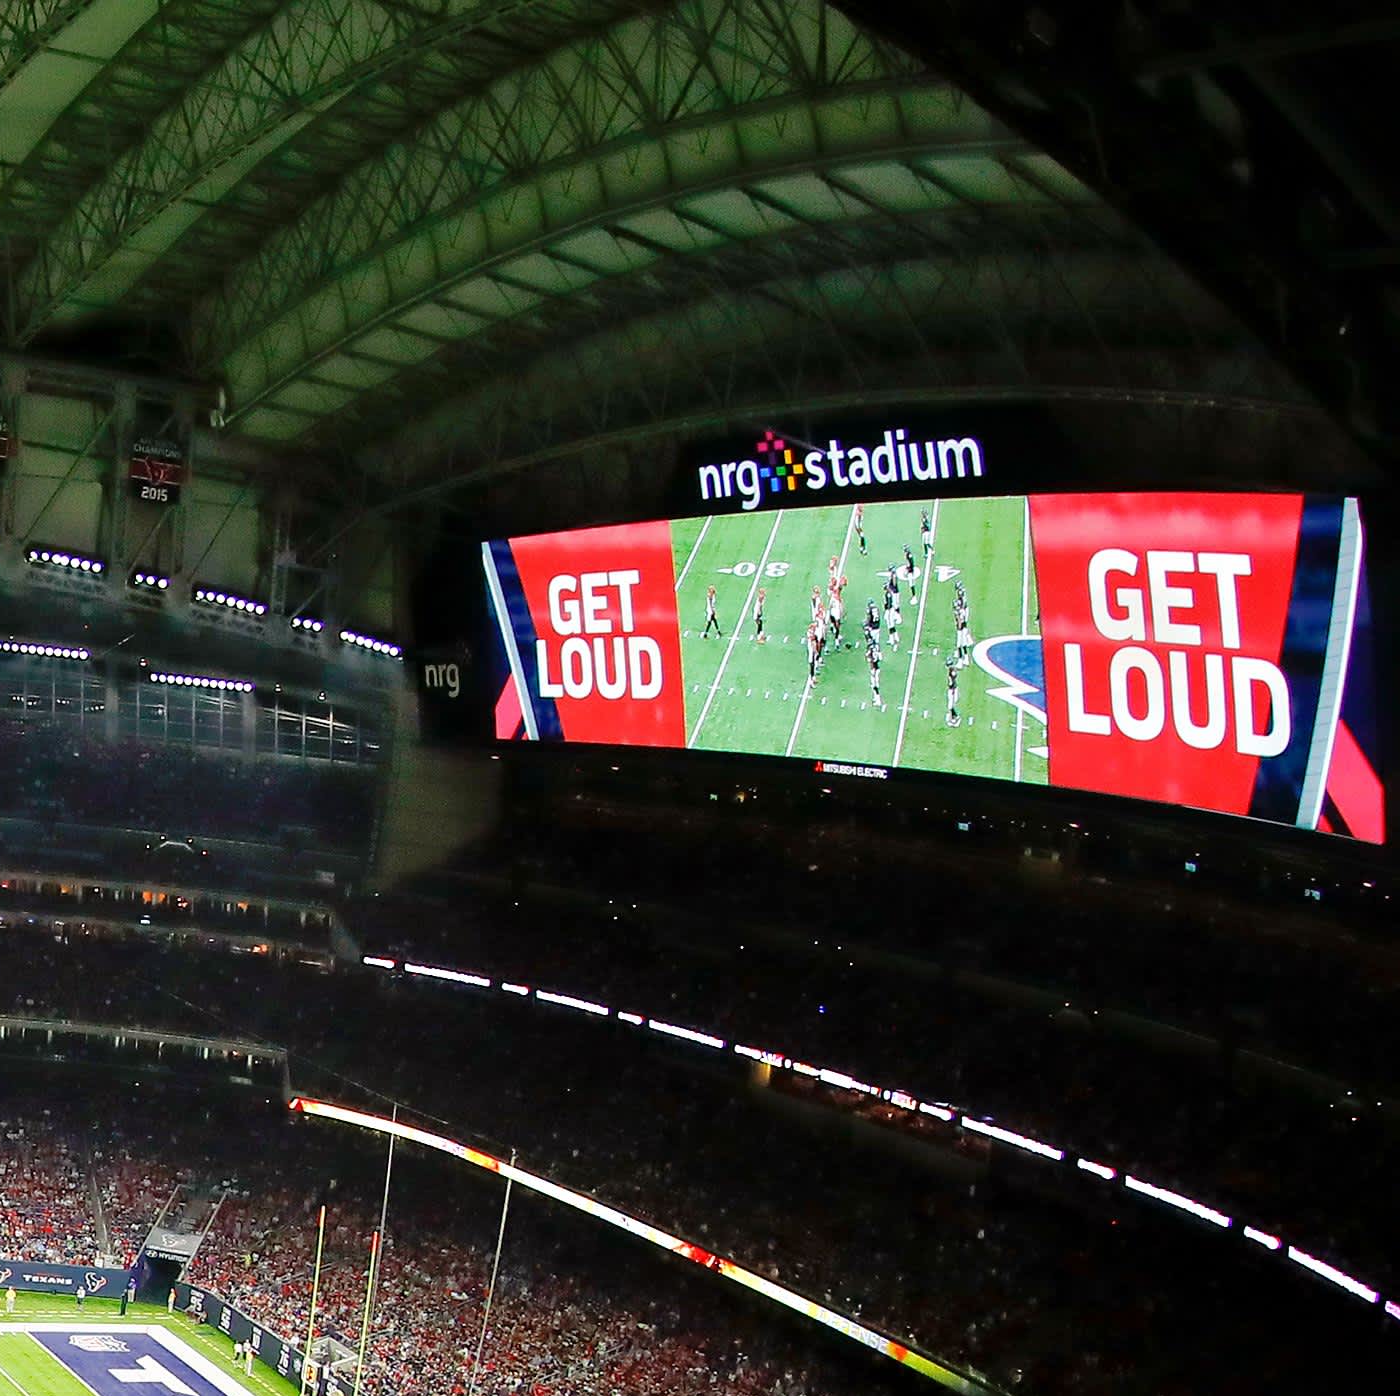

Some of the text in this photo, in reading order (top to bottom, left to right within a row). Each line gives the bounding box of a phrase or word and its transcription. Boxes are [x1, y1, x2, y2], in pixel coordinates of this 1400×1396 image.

[141, 486, 168, 502] 2015
[698, 428, 983, 510] nrg stadium
[547, 569, 641, 636] GET
[1087, 547, 1252, 650] GET
[424, 663, 460, 698] nrg
[535, 636, 663, 700] LOUD
[1063, 642, 1292, 758] LOUD
[22, 1273, 73, 1286] TEXANS
